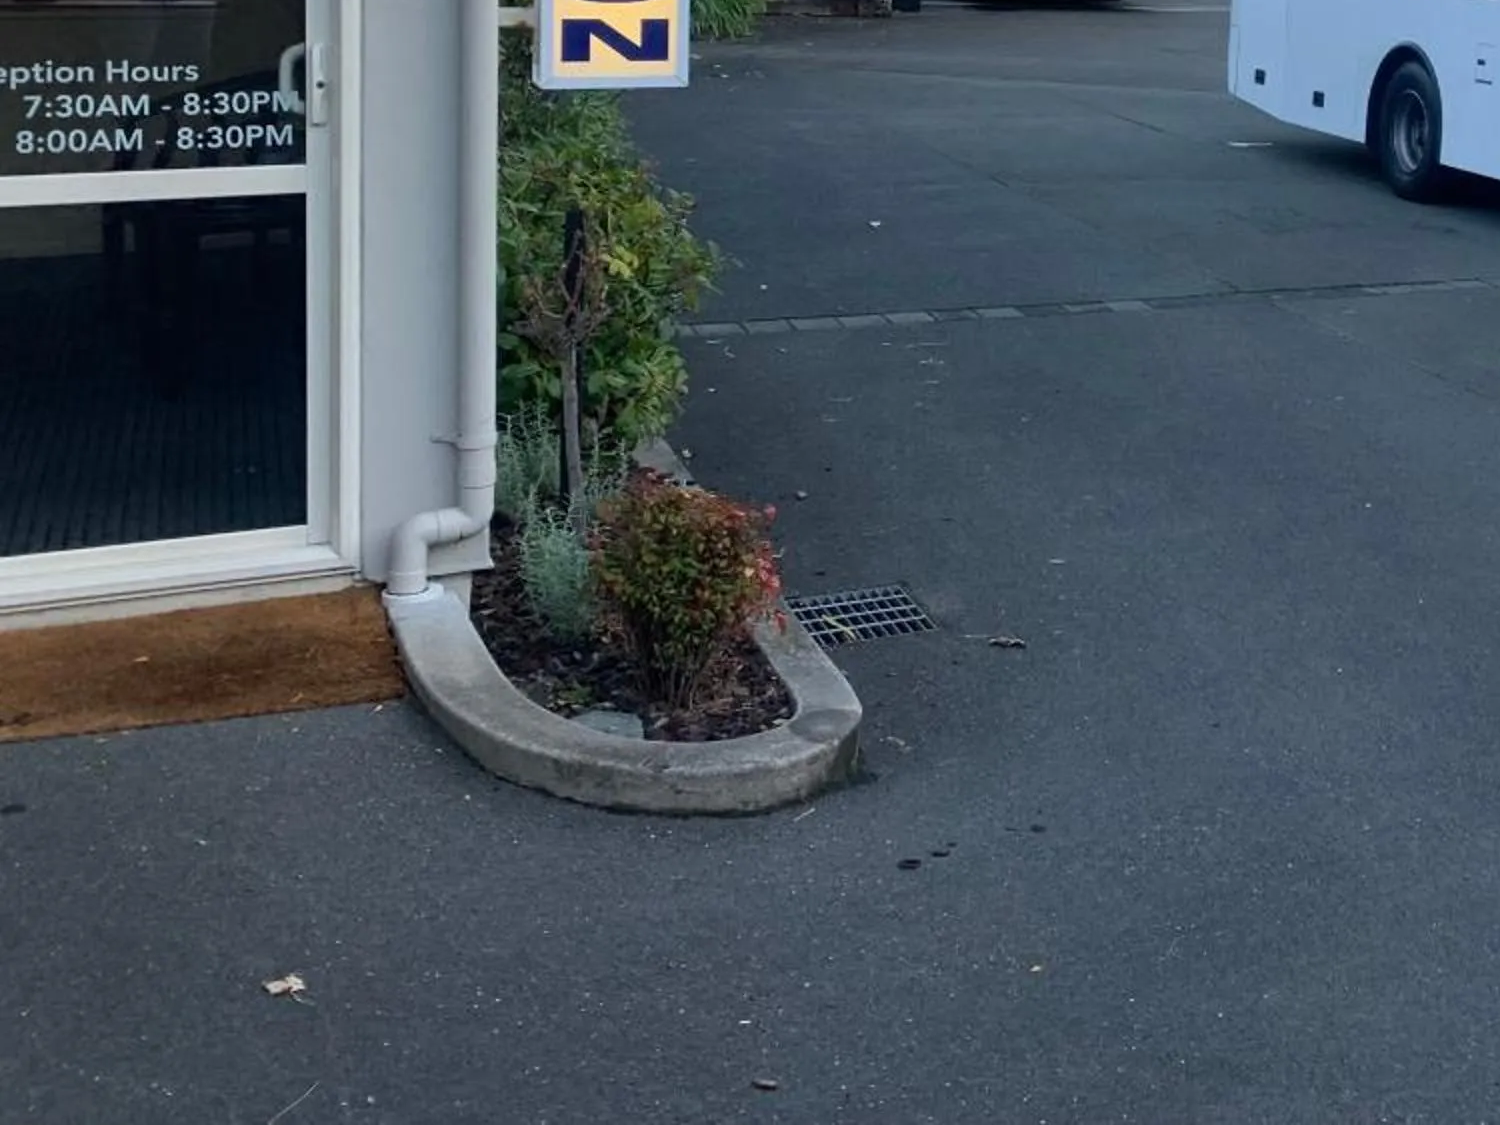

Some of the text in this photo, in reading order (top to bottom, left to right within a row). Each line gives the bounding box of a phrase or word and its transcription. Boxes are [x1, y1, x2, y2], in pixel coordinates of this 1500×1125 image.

[105, 59, 200, 83] Hours
[23, 94, 150, 119] 7:30AM
[183, 90, 299, 116] 8:30PM
[15, 128, 144, 154] 8:00AM
[176, 124, 294, 150] 8:30PM
